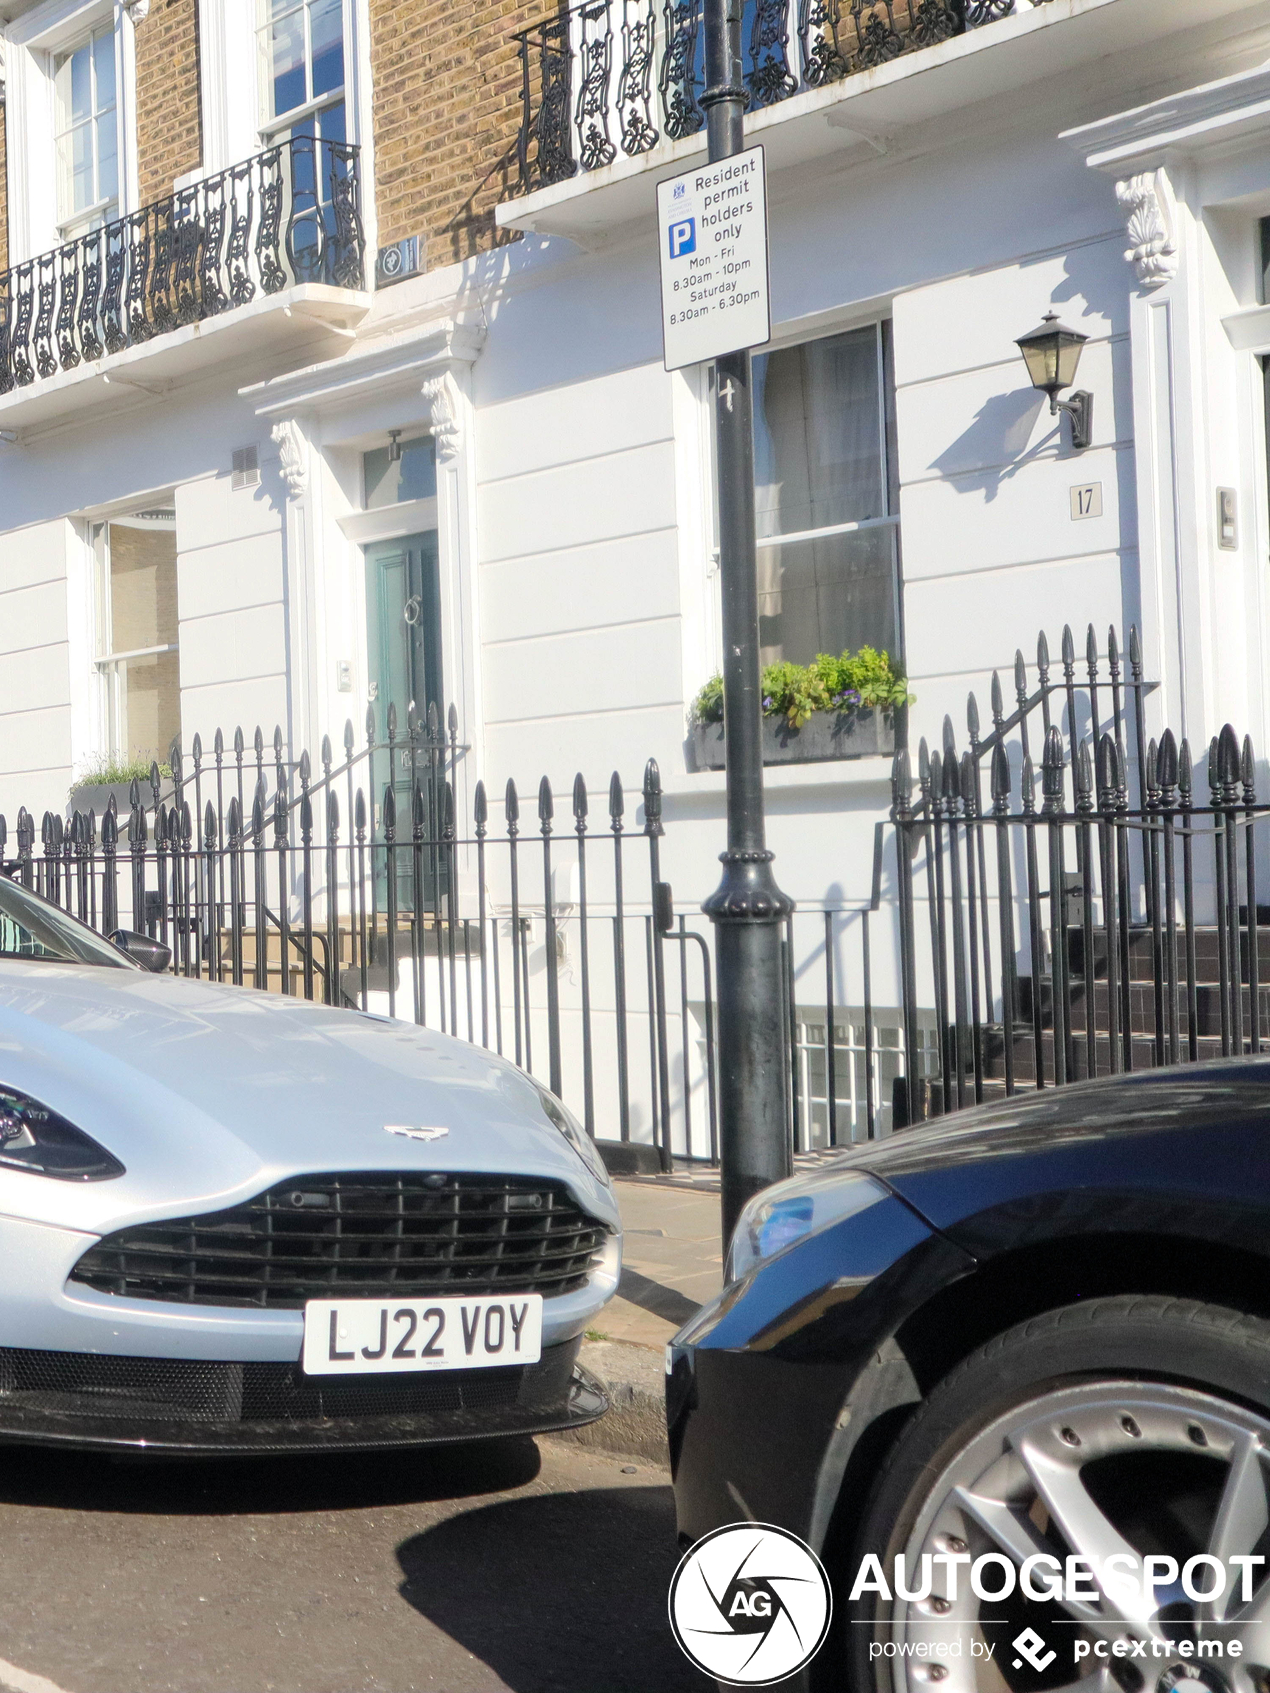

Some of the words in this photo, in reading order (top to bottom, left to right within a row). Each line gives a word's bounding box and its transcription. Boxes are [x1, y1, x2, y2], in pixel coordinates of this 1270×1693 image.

[695, 159, 755, 191] Resident
[704, 180, 750, 210] permit
[701, 200, 753, 229] holders
[672, 223, 691, 256] P
[714, 222, 742, 243] only
[689, 254, 711, 270] Mon
[721, 245, 735, 262] Fri
[673, 272, 712, 292] 8.30am
[722, 259, 751, 277] 10pm
[690, 280, 737, 302] Saturday
[670, 305, 709, 325] 8.30am
[719, 289, 760, 311] 6.30pm
[1078, 488, 1093, 515] 17
[328, 1307, 446, 1362] LJ22
[460, 1302, 529, 1356] VOY
